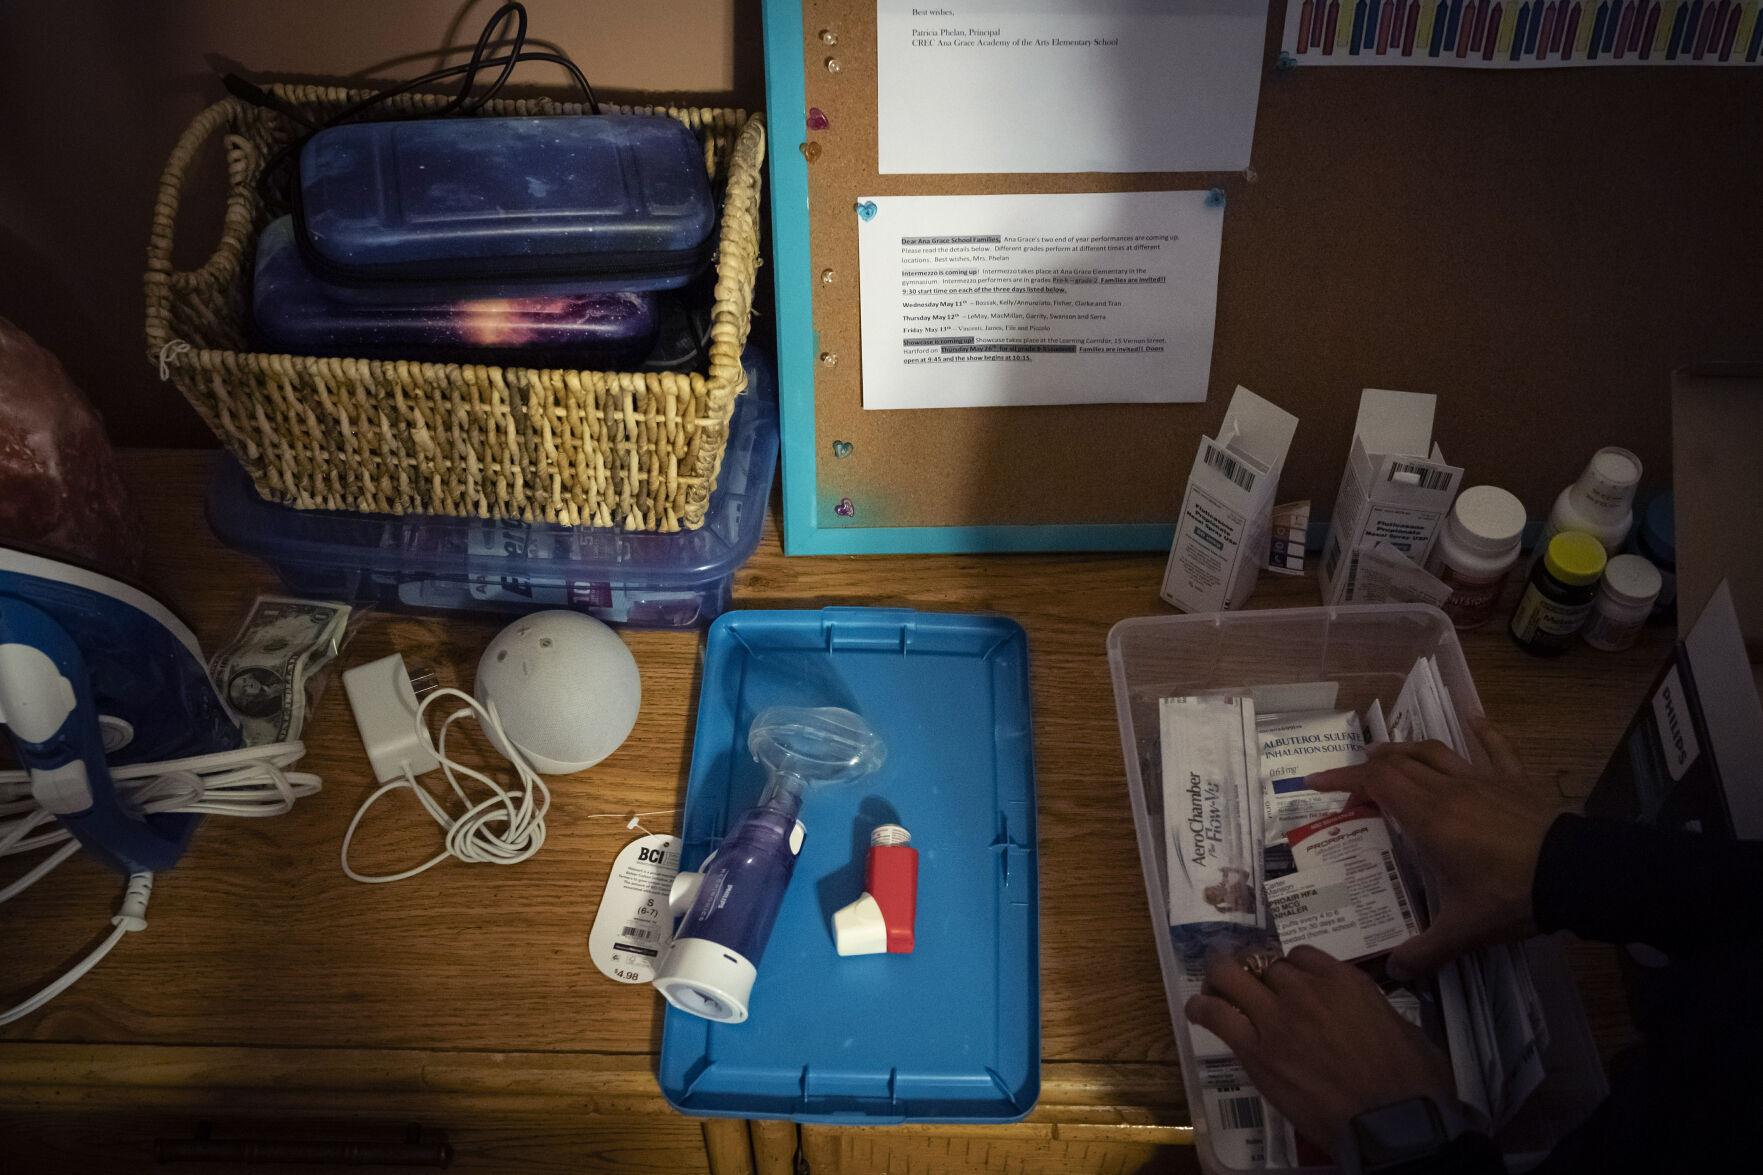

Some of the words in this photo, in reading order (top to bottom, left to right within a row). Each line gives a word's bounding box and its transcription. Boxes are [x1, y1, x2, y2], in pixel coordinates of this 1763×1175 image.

[912, 8, 928, 16] Best
[929, 8, 955, 17] wishes,
[912, 28, 938, 37] Patricia
[940, 28, 967, 38] Phelan,
[969, 28, 1001, 38] Principal
[912, 39, 937, 47] CREC
[938, 39, 952, 47] Ana
[954, 39, 975, 47] Grace
[977, 38, 1010, 48] Academy
[1012, 38, 1020, 47] of
[1021, 38, 1032, 47] the
[1034, 38, 1050, 47] Arts
[1052, 38, 1092, 48] Elementary
[1093, 38, 1119, 46] School
[1090, 236, 1134, 244] performances
[902, 246, 921, 254] Please
[922, 246, 937, 254] read
[1035, 268, 1052, 276] place
[1060, 268, 1073, 276] Ana
[1073, 268, 1092, 276] Grace
[1092, 268, 1128, 276] Elementary
[977, 277, 1012, 285] performers
[1030, 277, 1051, 285] grades
[1100, 276, 1127, 284] Families
[1127, 276, 1139, 284] are
[1012, 286, 1026, 294] days
[1026, 286, 1045, 294] listed
[940, 301, 954, 309] May
[1074, 300, 1094, 308] Clarke
[1108, 300, 1122, 308] Tran
[932, 314, 946, 322] May
[990, 312, 1025, 320] MacMillan,
[903, 327, 924, 335] Friday
[924, 326, 939, 334] May
[904, 338, 934, 346] Showcase
[940, 338, 962, 346] coming
[976, 336, 1005, 344] Showcase
[1006, 336, 1022, 344] takes
[1023, 336, 1040, 344] place
[1046, 336, 1059, 344] the
[1059, 336, 1085, 345] Learning
[941, 346, 970, 354] Thursday
[970, 346, 984, 354] May
[903, 358, 920, 366] open
[928, 356, 942, 364] 9:45
[942, 356, 955, 364] and
[984, 354, 1004, 363] begins
[1662, 687, 1687, 765] PHILIPS
[1264, 734, 1323, 750] ALBUTEROL
[1324, 732, 1361, 742] SULFATE
[1265, 746, 1321, 759] INHALATION
[1186, 771, 1206, 867] AeroChamber
[638, 846, 665, 864] BCI
[647, 898, 654, 907] S
[638, 906, 658, 918] (6-7)
[614, 968, 639, 981] $4.98
